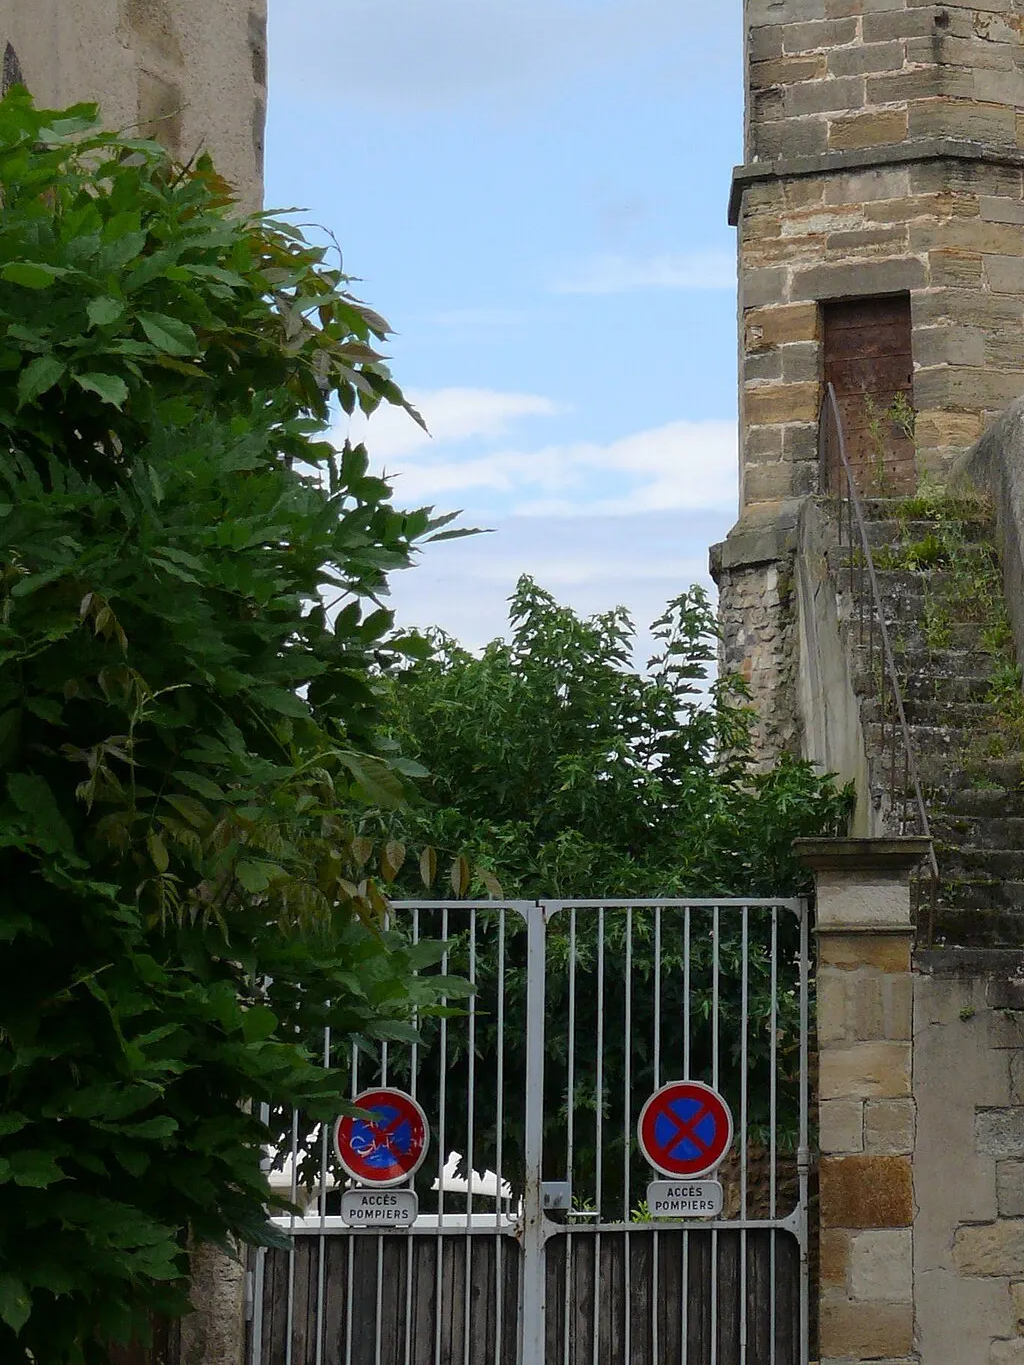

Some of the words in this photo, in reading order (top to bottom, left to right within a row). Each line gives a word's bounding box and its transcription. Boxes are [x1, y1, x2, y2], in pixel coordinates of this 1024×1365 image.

[667, 1185, 703, 1197] ACCÈS
[361, 1194, 397, 1206] ACCÈS
[655, 1200, 714, 1210] POMPIERS
[349, 1209, 409, 1219] POMPIERS
